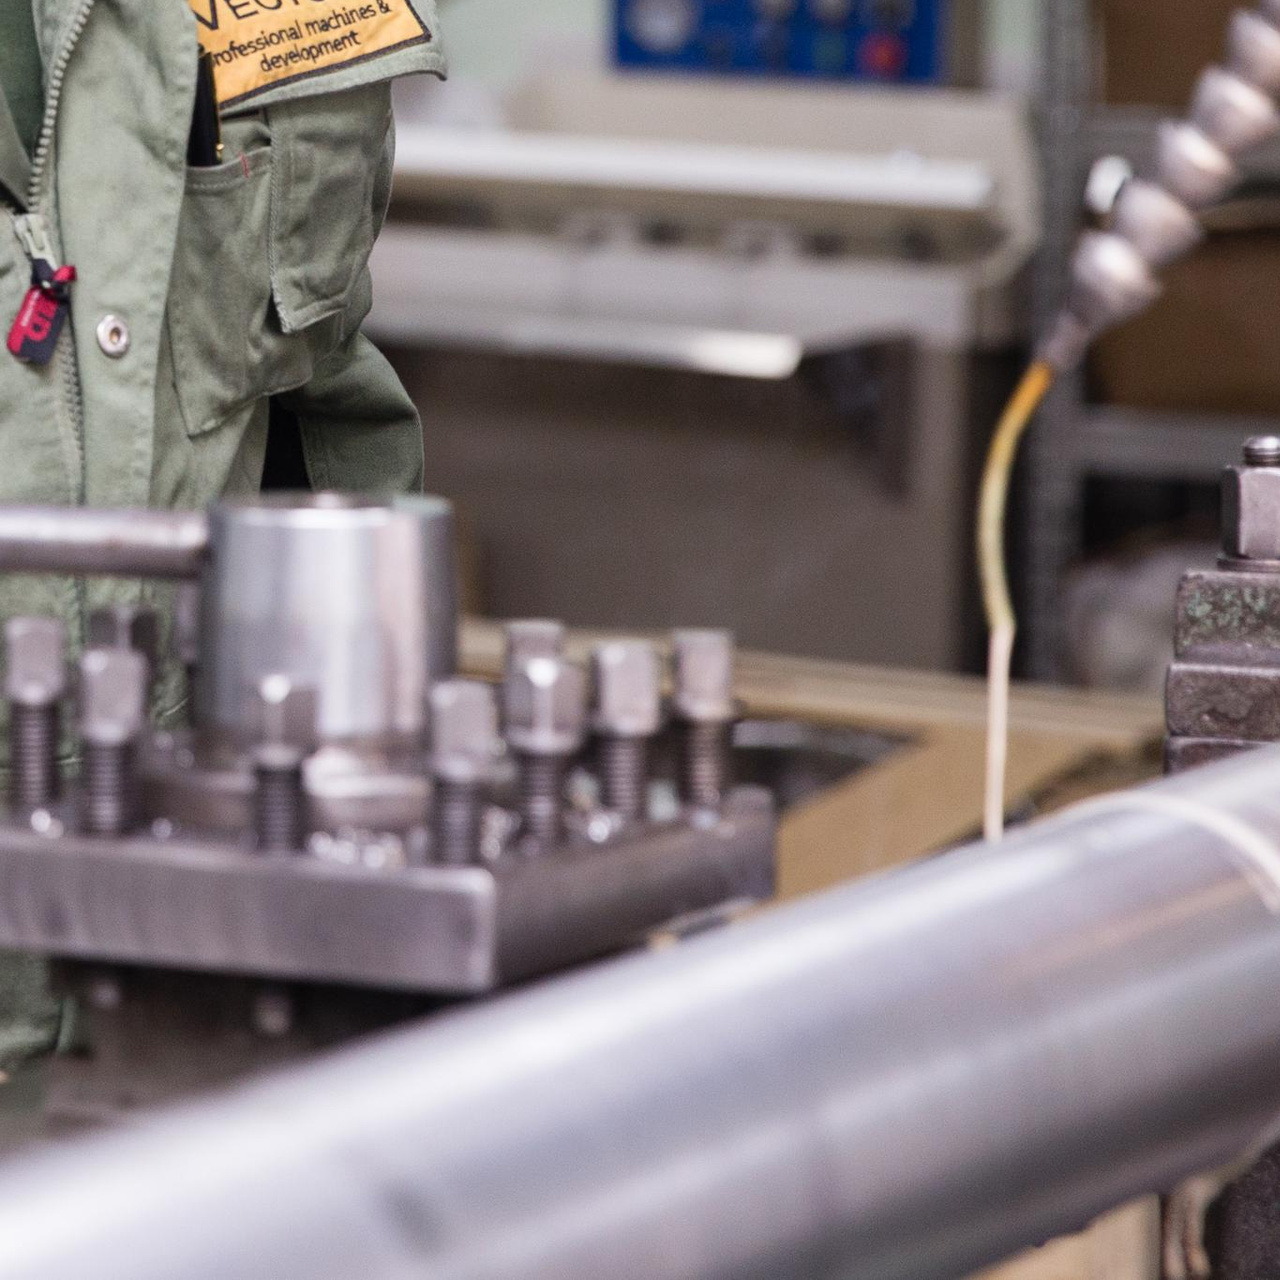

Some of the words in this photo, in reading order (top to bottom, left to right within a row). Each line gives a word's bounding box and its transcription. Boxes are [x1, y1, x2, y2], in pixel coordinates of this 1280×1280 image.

[211, 22, 303, 67] rofessional
[305, 2, 376, 37] machines
[260, 31, 362, 72] development
